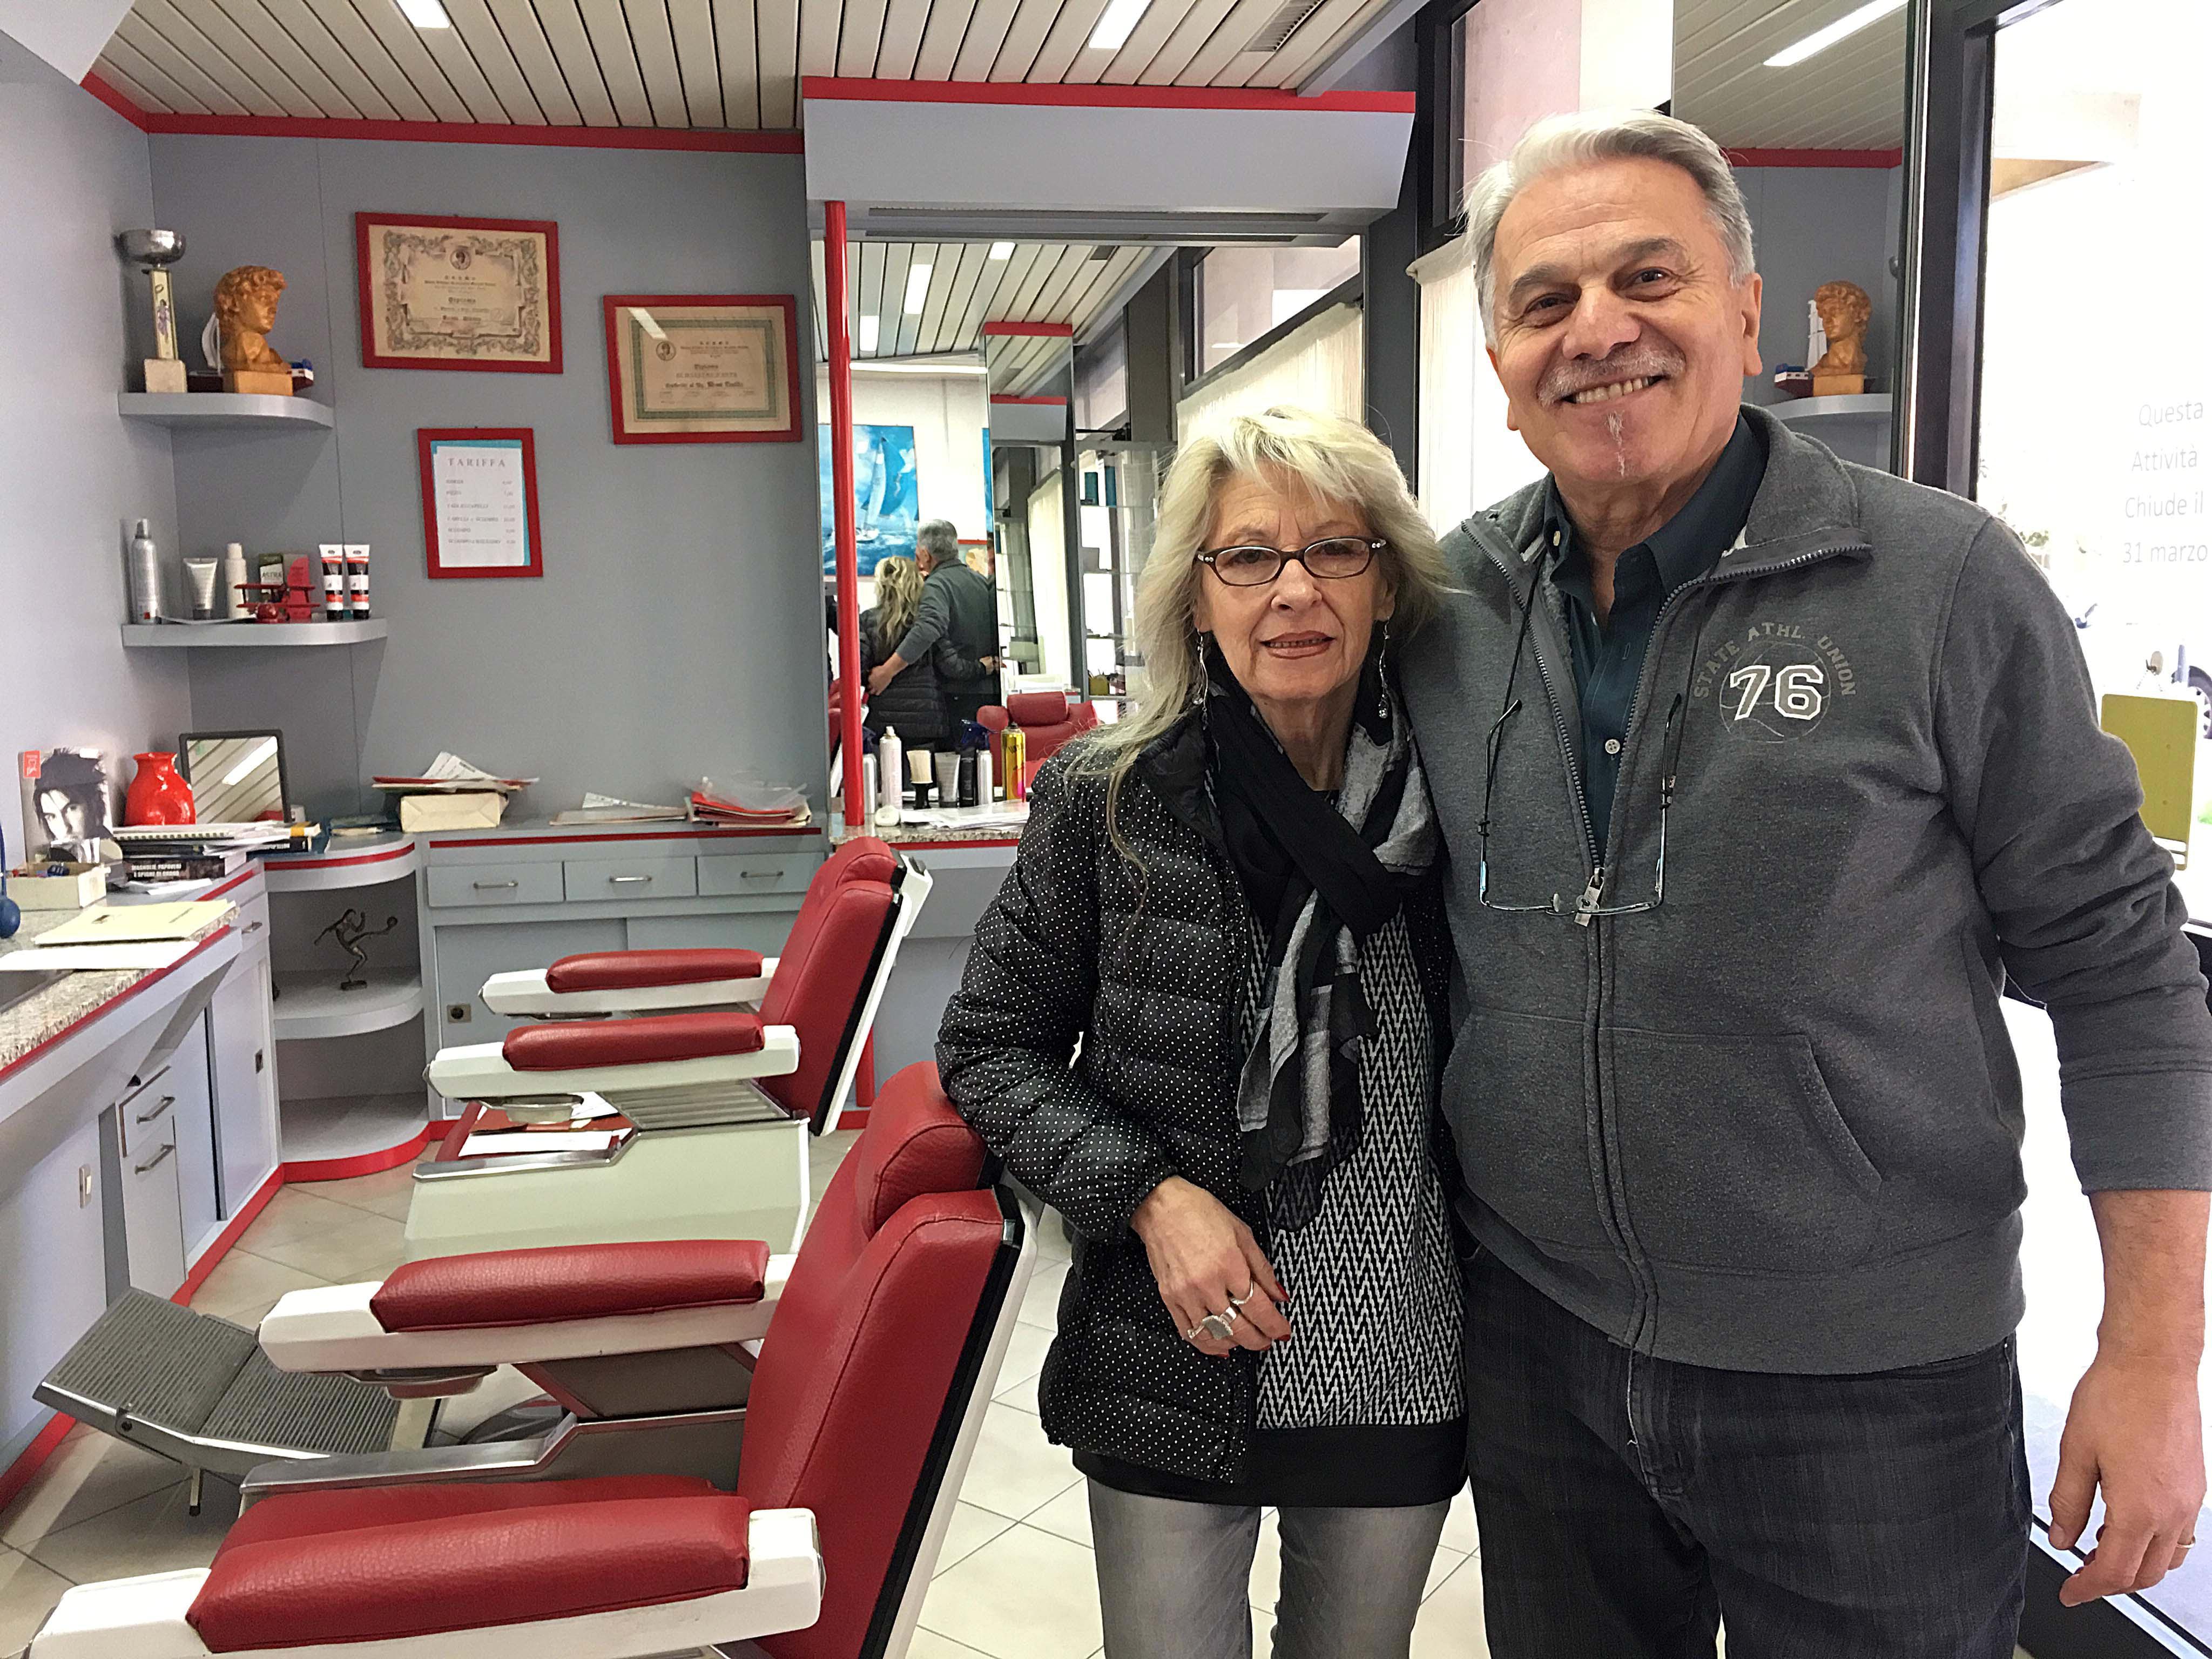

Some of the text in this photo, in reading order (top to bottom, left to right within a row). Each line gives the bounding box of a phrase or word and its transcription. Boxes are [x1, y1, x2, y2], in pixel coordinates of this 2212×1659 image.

[2139, 401, 2203, 427] Questa
[448, 458, 505, 467] TARIFFA
[2131, 444, 2198, 471] Attività
[2125, 490, 2204, 518] Chiude il
[2123, 542, 2208, 563] 31 marzo
[1694, 622, 1856, 699] STATE ATHL. UNION
[1730, 665, 1824, 720] 76
